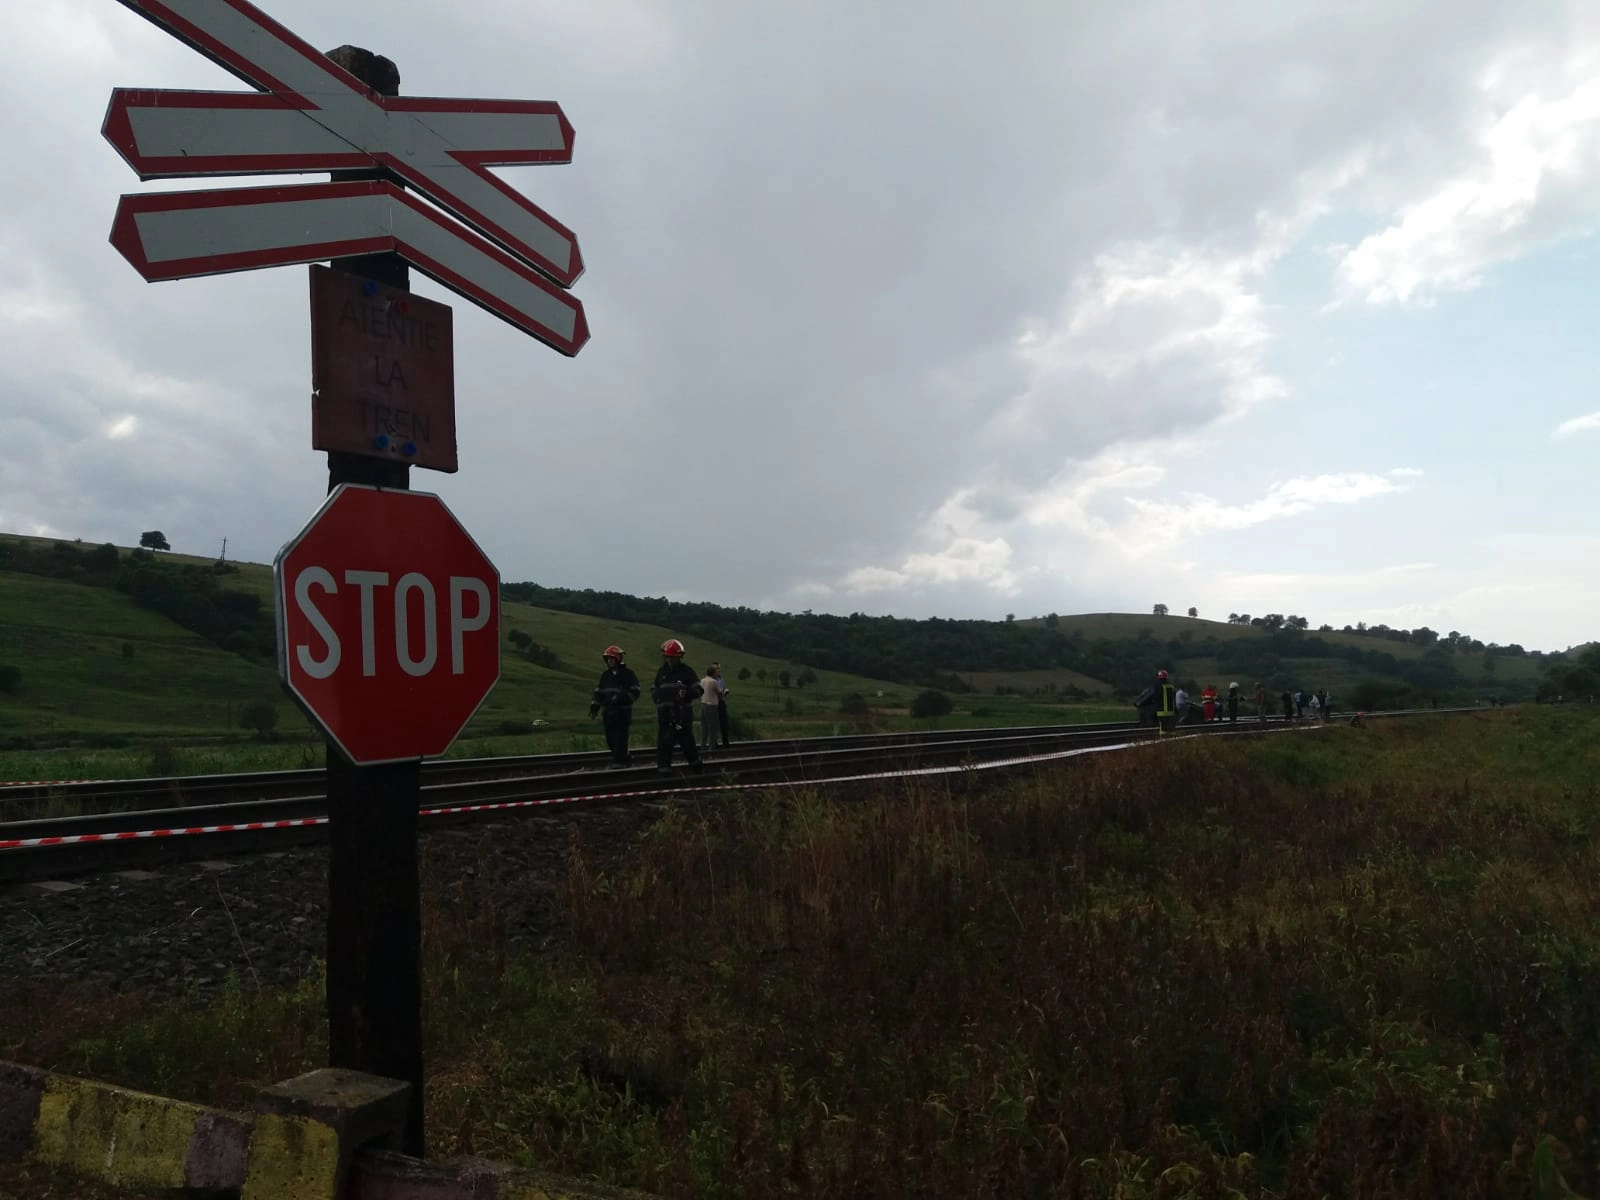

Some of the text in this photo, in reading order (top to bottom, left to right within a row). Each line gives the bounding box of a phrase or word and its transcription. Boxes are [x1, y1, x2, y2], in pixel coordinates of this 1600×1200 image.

[338, 298, 441, 352] ATENTIE
[375, 355, 408, 390] LA
[356, 399, 431, 442] TREN
[294, 566, 491, 679] STOP
